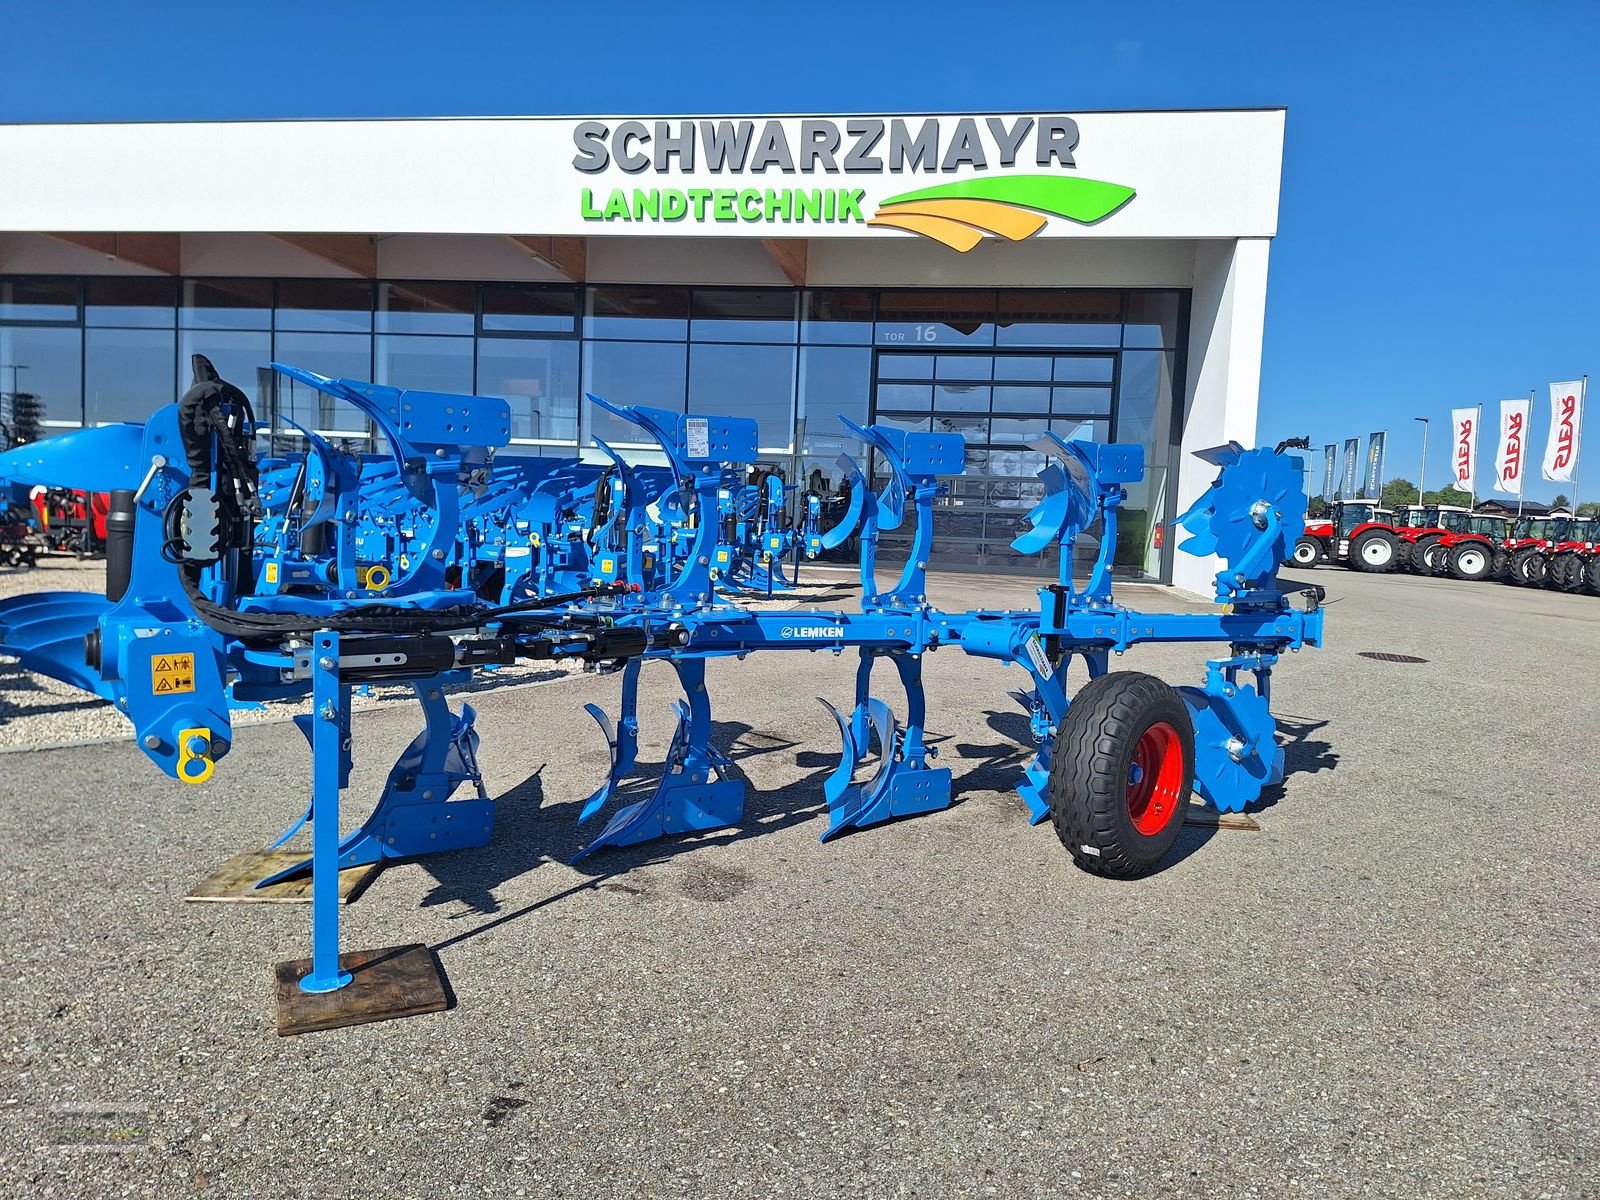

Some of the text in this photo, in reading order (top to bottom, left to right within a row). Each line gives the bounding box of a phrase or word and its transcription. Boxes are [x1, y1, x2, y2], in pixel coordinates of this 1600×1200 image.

[571, 116, 1080, 174] SCHWARZMAYR
[581, 187, 866, 223] LANDTECHNIK
[884, 325, 937, 341] TOR 16
[794, 627, 844, 639] LEMKEN
